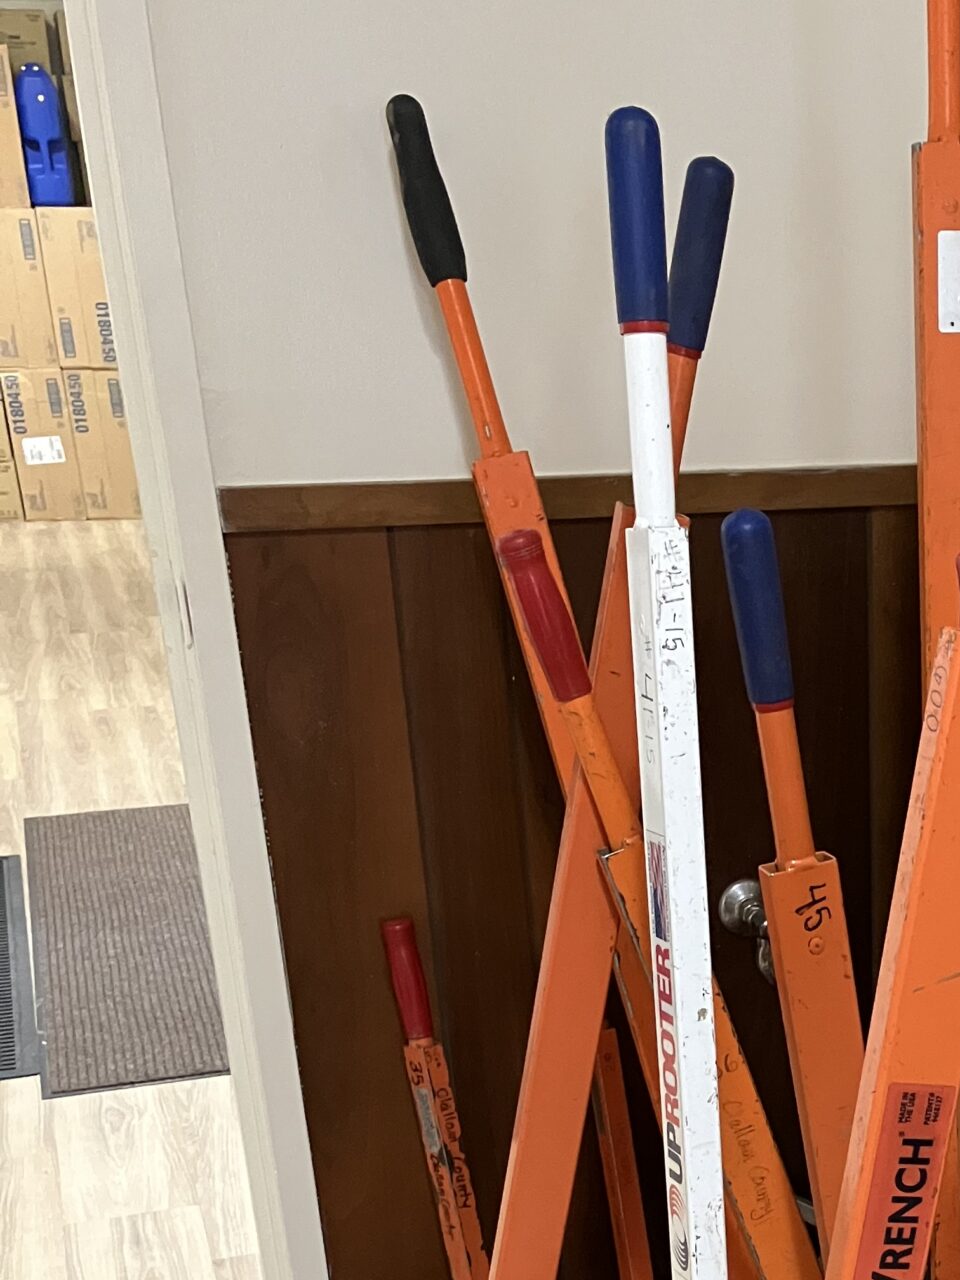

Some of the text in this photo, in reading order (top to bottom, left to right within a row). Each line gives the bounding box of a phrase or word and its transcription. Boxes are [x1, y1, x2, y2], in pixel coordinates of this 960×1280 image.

[5, 375, 27, 434] 0180450
[67, 374, 89, 433] 0180450
[794, 882, 832, 932] 45
[409, 1060, 424, 1086] 35
[655, 943, 686, 1185] UPROOTER
